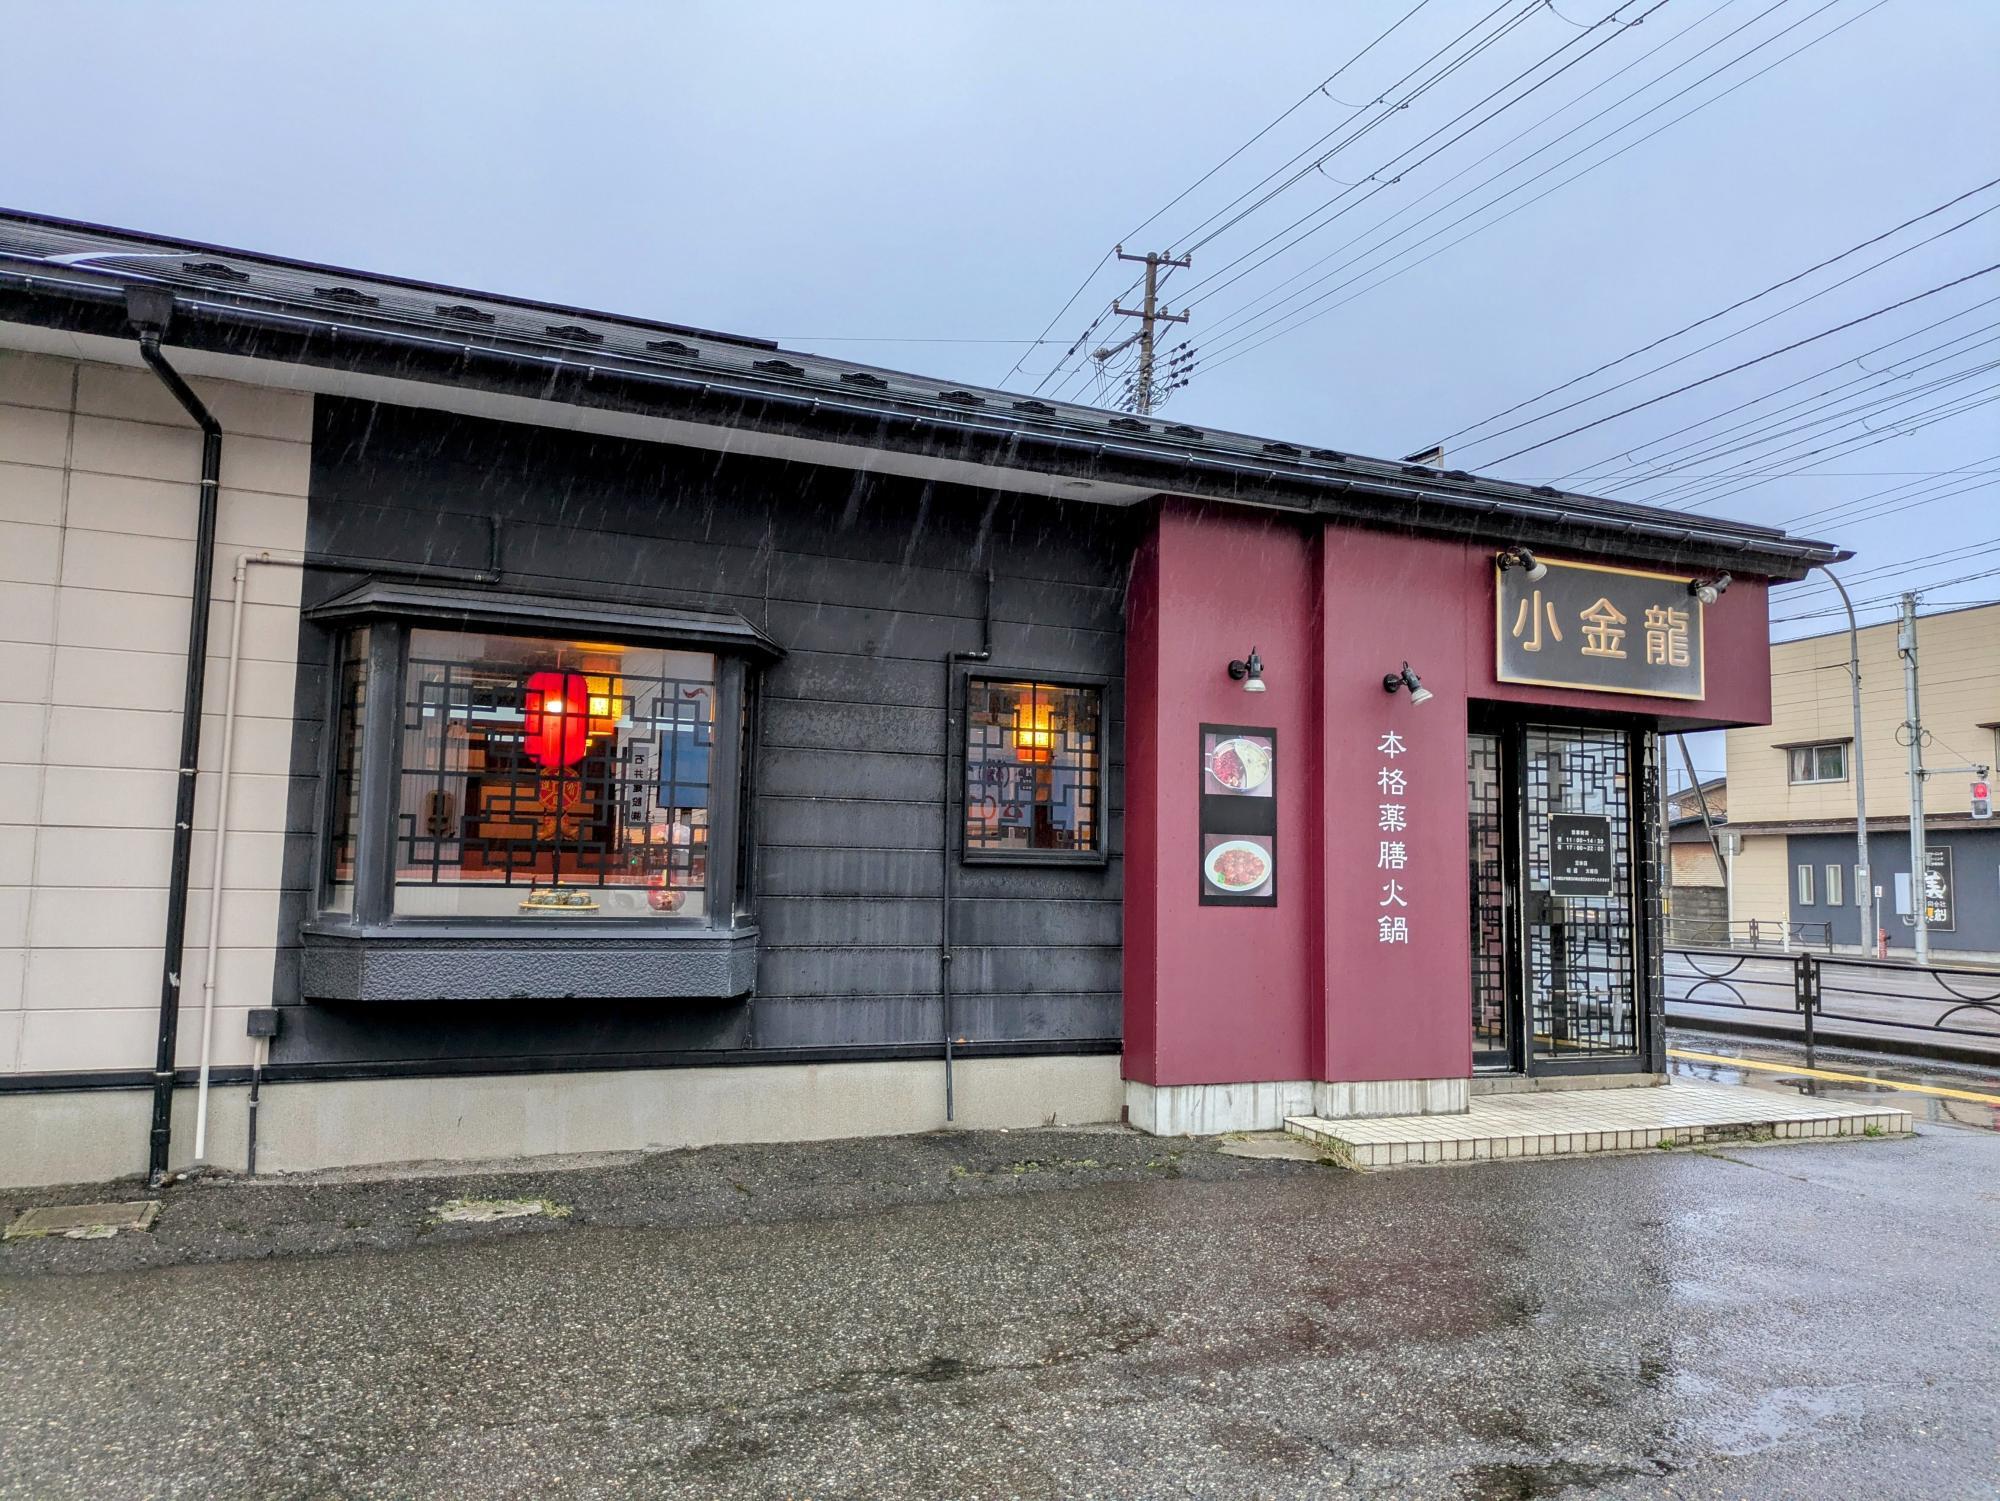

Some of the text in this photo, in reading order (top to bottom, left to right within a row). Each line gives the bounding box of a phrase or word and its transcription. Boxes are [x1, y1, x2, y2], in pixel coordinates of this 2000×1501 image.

[1512, 590, 1691, 667] 小金龍
[1377, 730, 1409, 944] 本格薬膳火鍋
